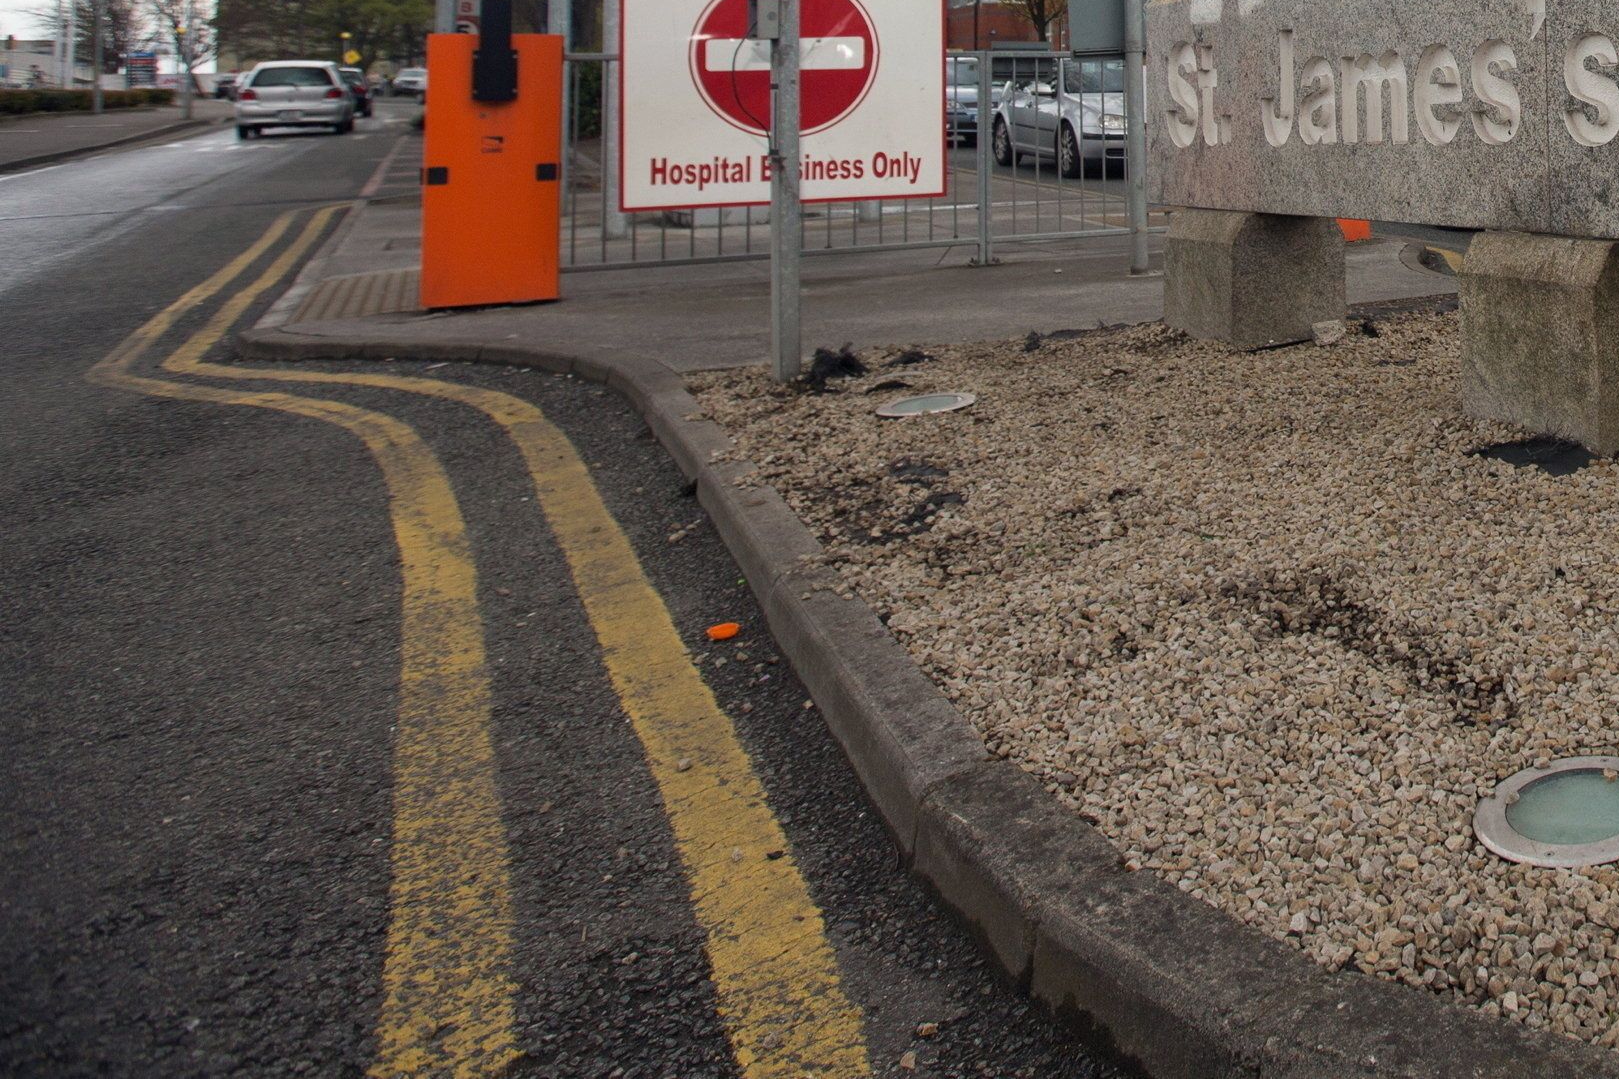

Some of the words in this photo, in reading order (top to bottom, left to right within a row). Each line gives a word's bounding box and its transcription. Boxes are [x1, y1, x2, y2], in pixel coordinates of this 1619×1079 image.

[1166, 39, 1232, 149] St.
[650, 155, 752, 191] Hospital
[760, 153, 864, 183] Biness
[872, 151, 922, 184] Only
